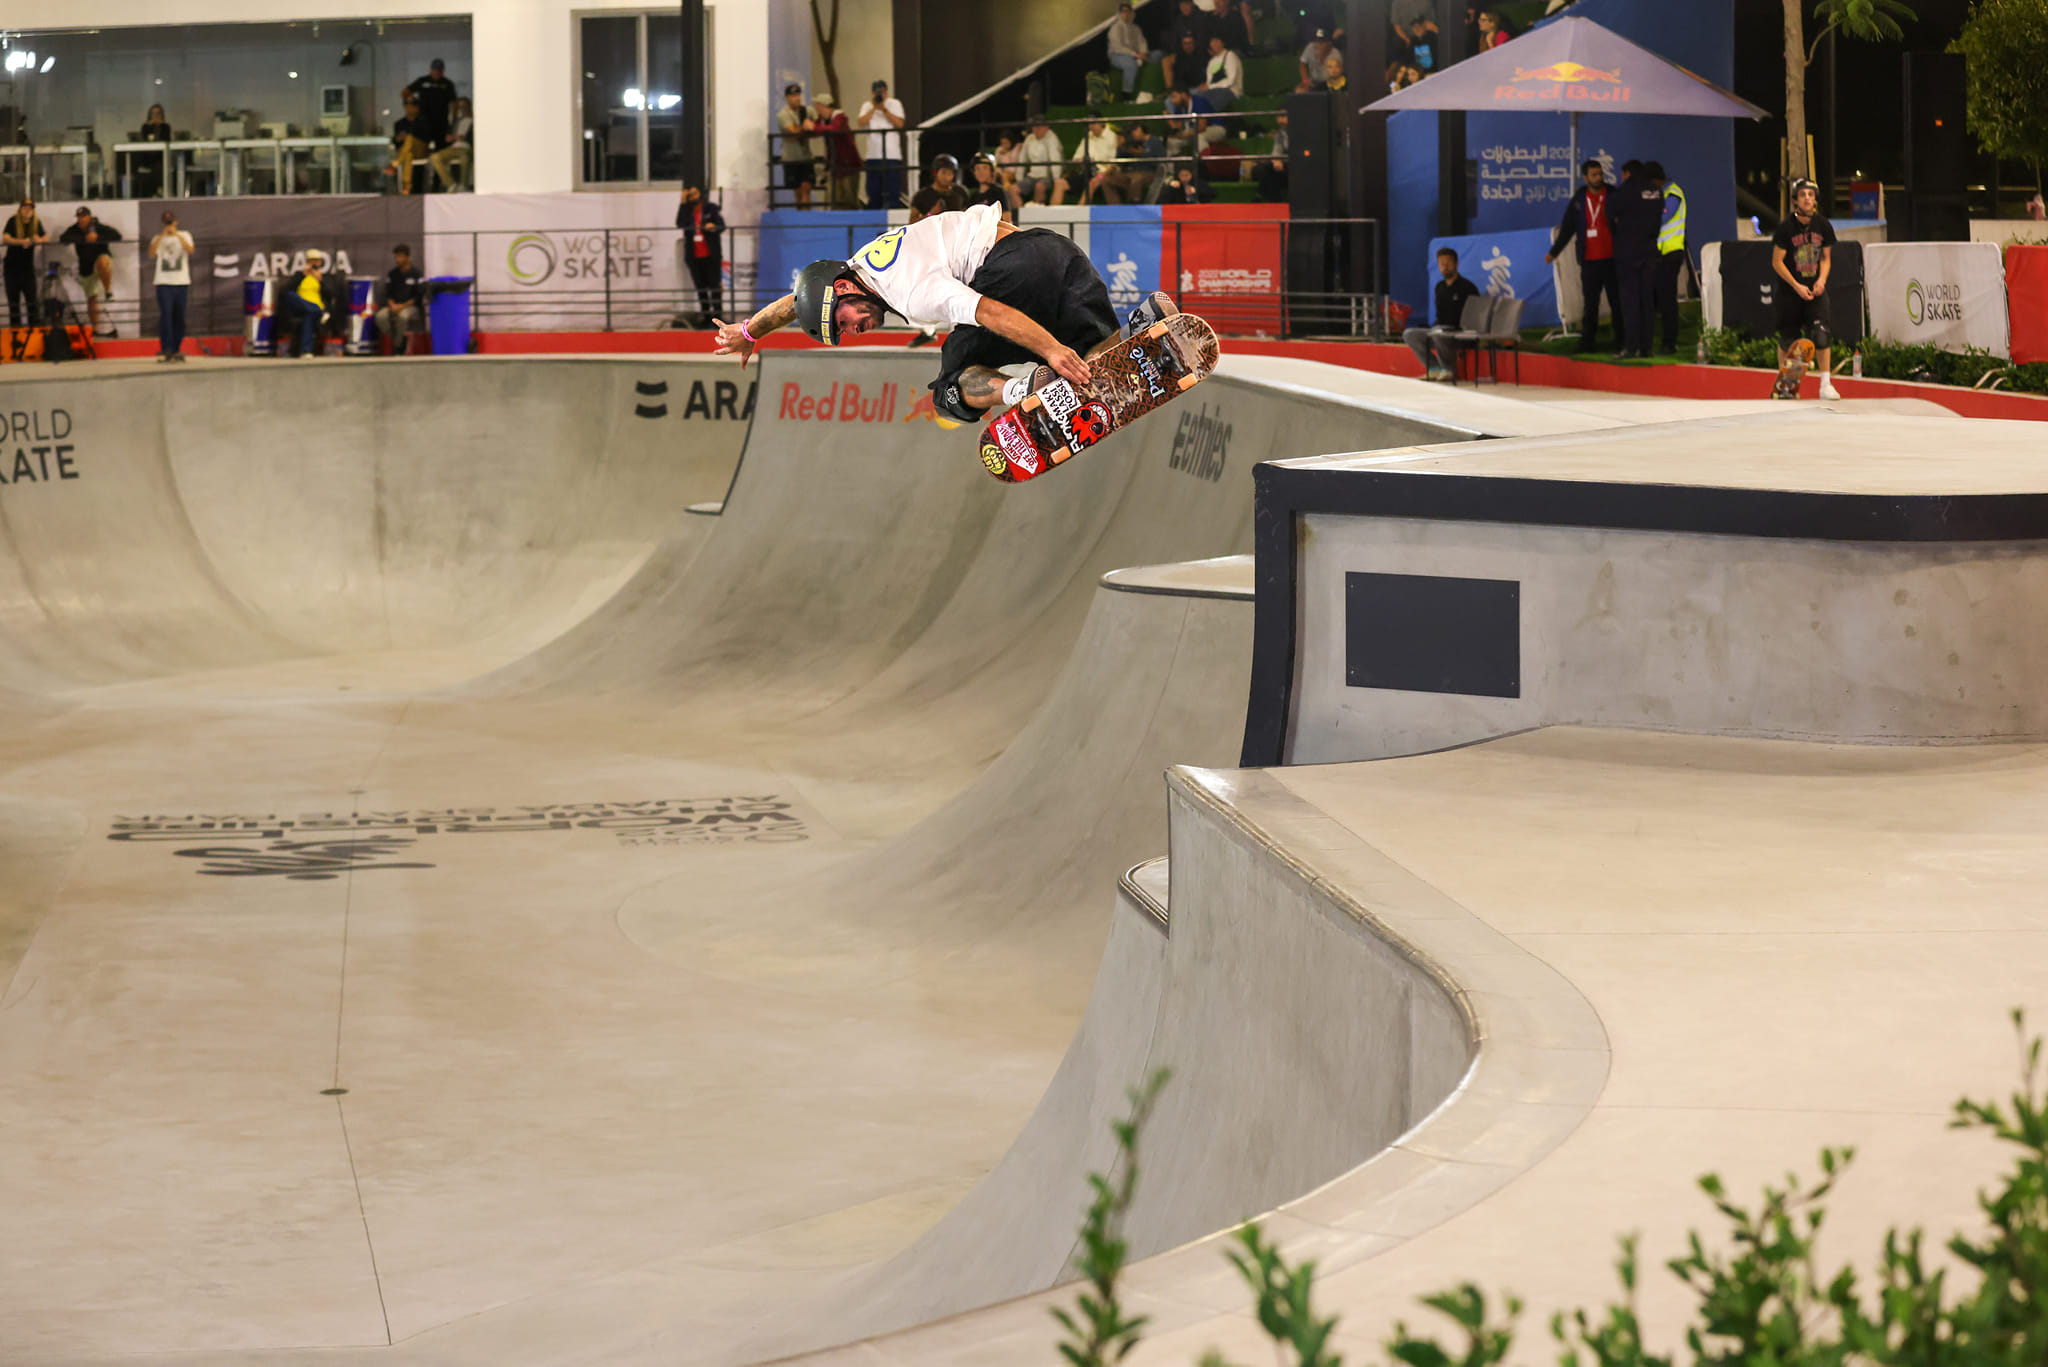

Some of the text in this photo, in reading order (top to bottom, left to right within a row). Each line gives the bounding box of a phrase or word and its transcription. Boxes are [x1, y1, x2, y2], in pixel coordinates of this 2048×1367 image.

[1494, 84, 1631, 102] Red Bull
[563, 235, 653, 255] WORLD
[563, 256, 653, 278] SKATE
[1220, 269, 1272, 279] WORLD
[1926, 284, 1961, 301] WORLD
[1927, 303, 1962, 321] SKATE
[780, 381, 898, 423] Red Bull
[1041, 387, 1063, 417] MAKA
[1050, 387, 1069, 413] LASSI
[1055, 380, 1077, 408] POSSE
[1004, 443, 1020, 463] VANS
[1010, 438, 1026, 456] THE
[0, 444, 80, 484] ATE
